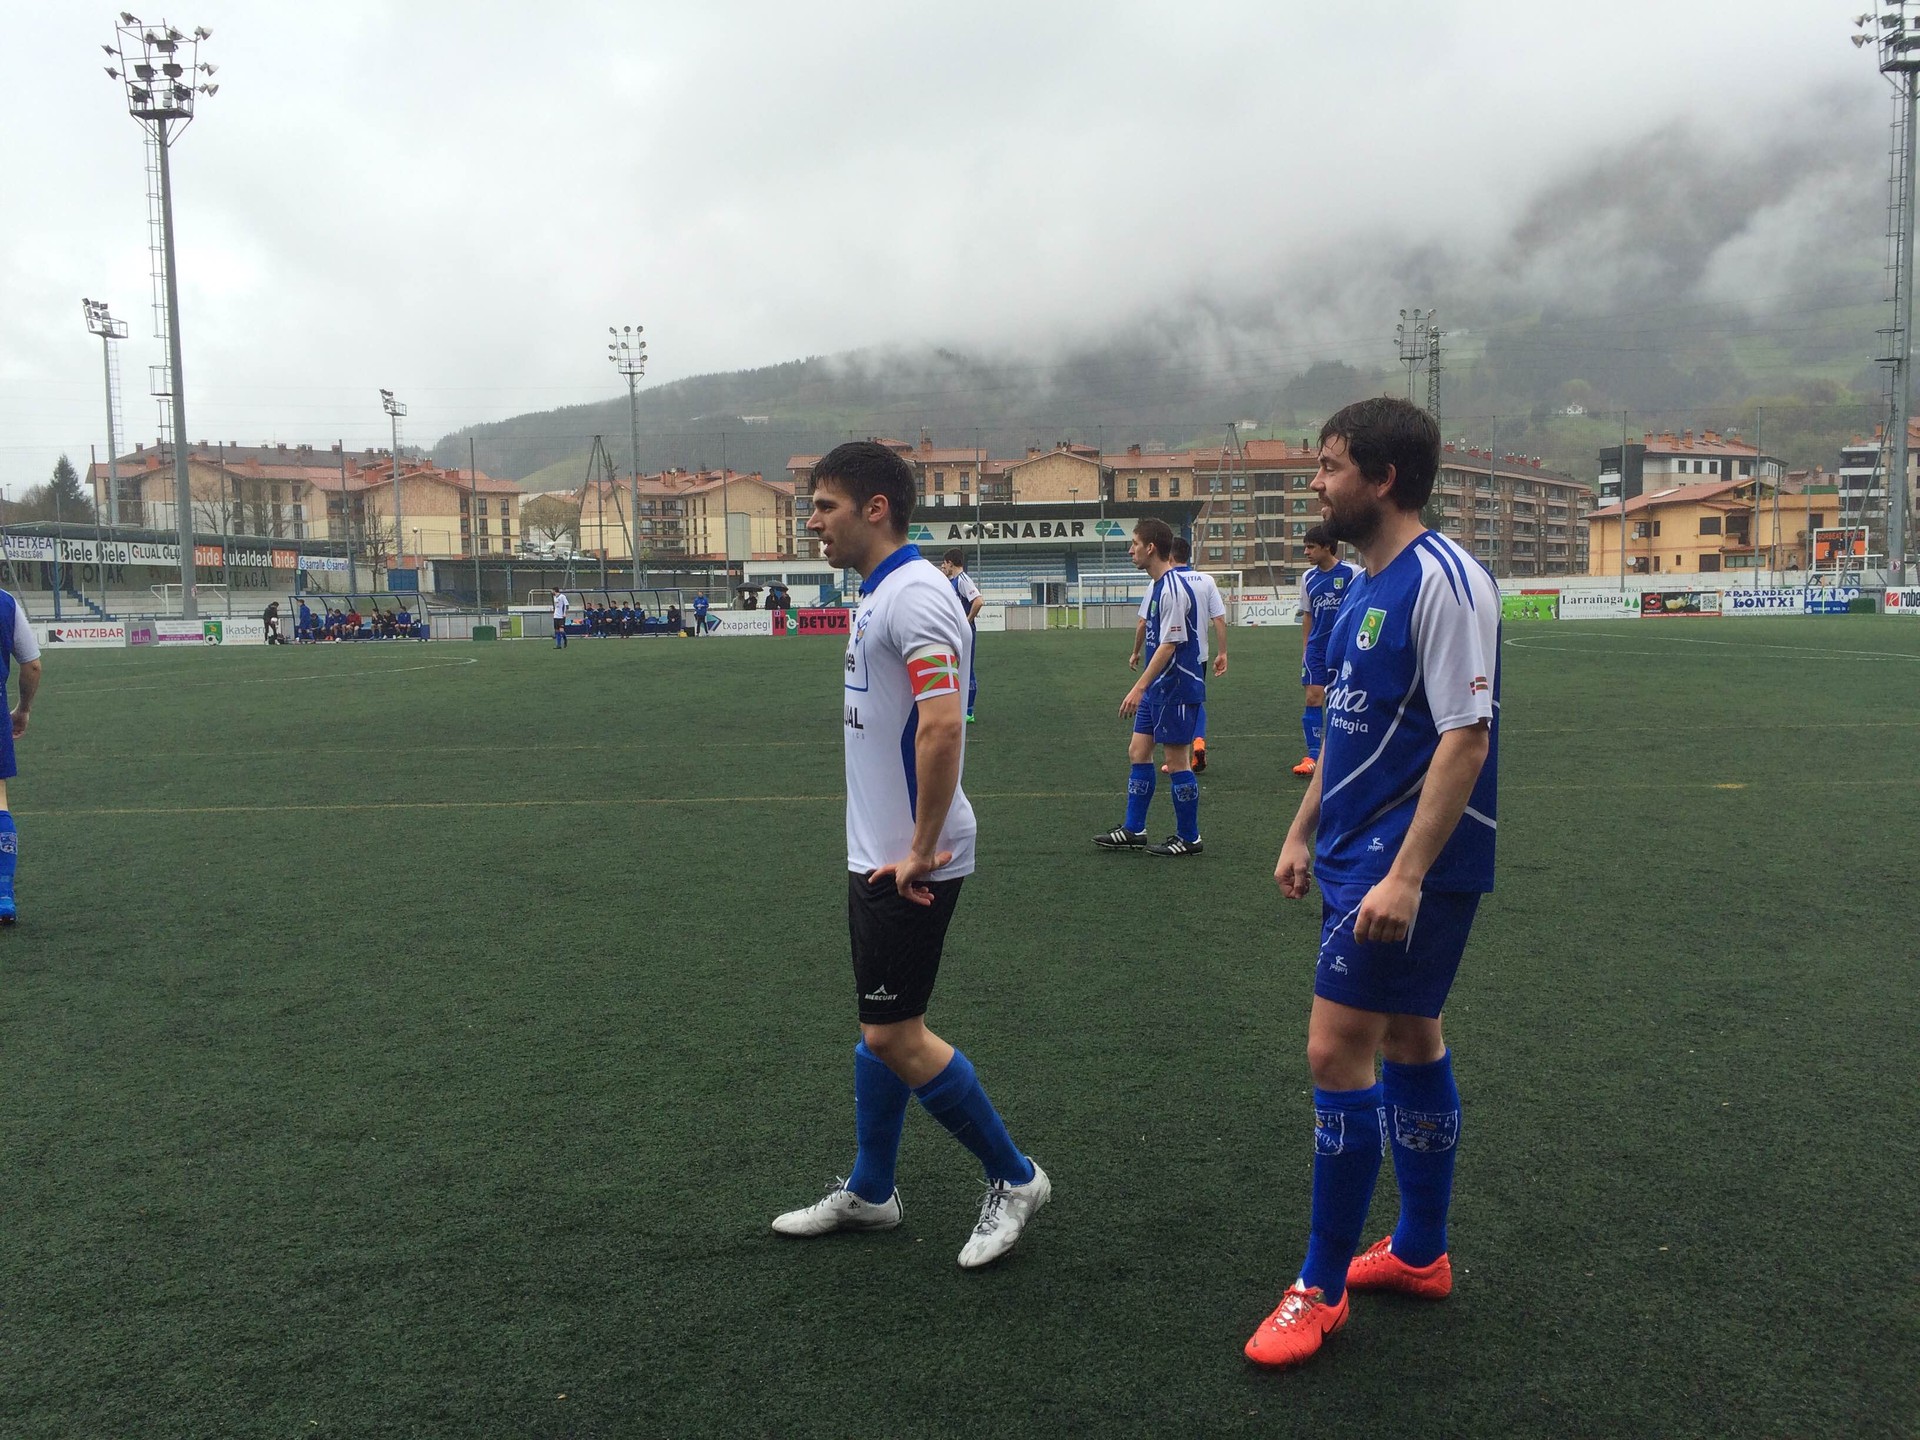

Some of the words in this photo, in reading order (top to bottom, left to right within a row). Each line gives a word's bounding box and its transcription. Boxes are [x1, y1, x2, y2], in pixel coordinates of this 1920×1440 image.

[61, 540, 93, 561] Biele
[195, 549, 220, 566] bide
[1562, 594, 1624, 606] Larrañaga
[722, 618, 771, 632] txapartegi
[66, 628, 124, 639] ANTZIBAR
